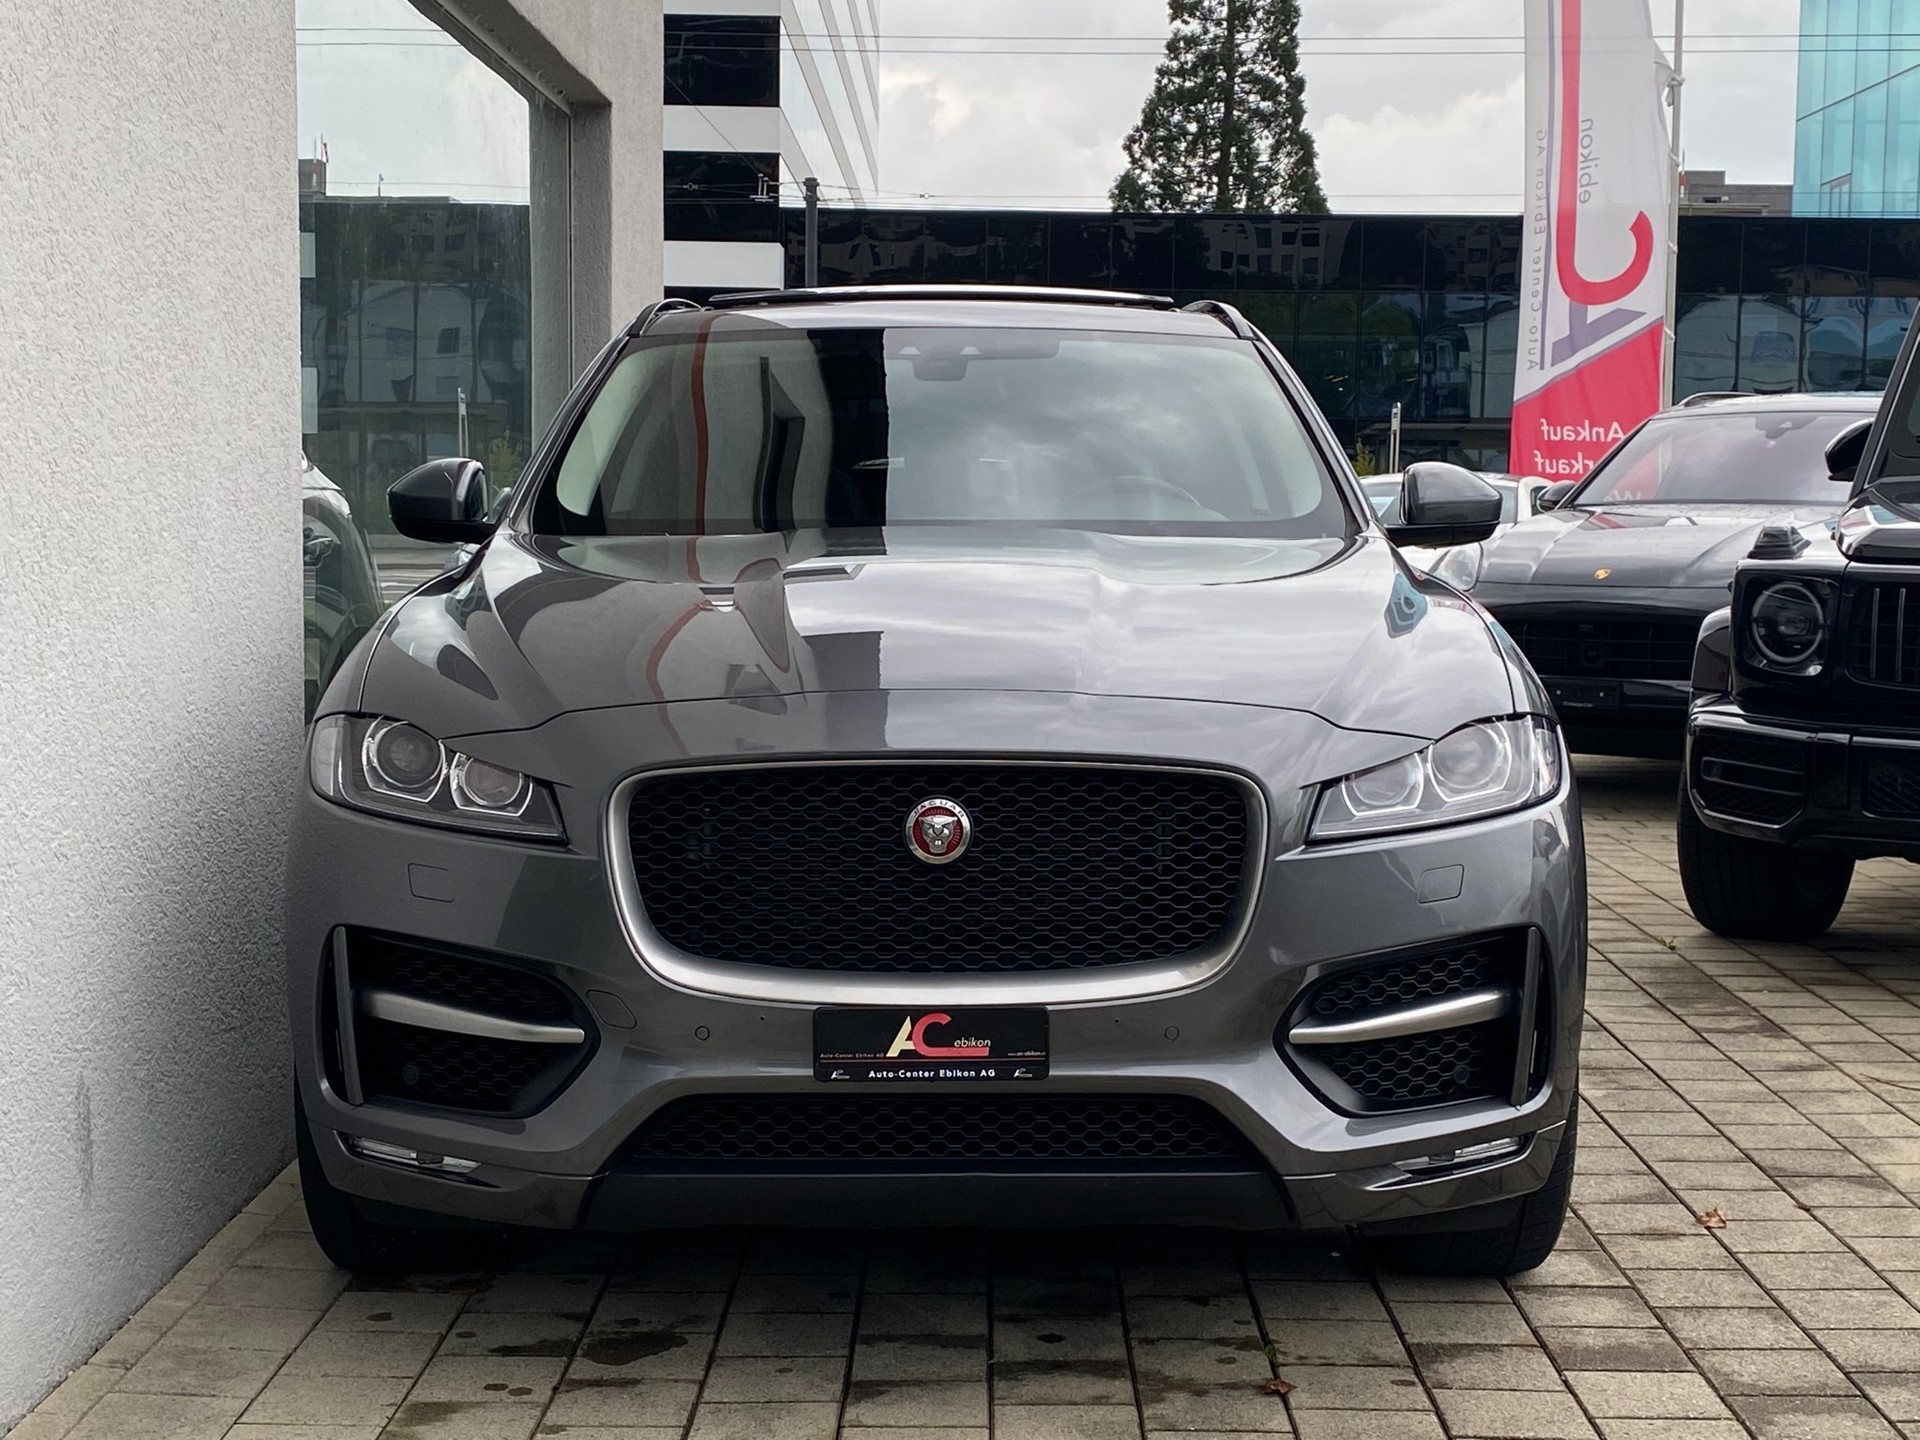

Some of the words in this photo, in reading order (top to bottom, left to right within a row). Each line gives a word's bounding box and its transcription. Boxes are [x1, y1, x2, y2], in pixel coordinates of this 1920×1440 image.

[913, 800, 965, 818] JAGUAR
[954, 1036, 991, 1049] ebikon
[868, 1069, 934, 1079] Auto-Center
[939, 1068, 976, 1078] Ebikon
[980, 1068, 996, 1078] AG
